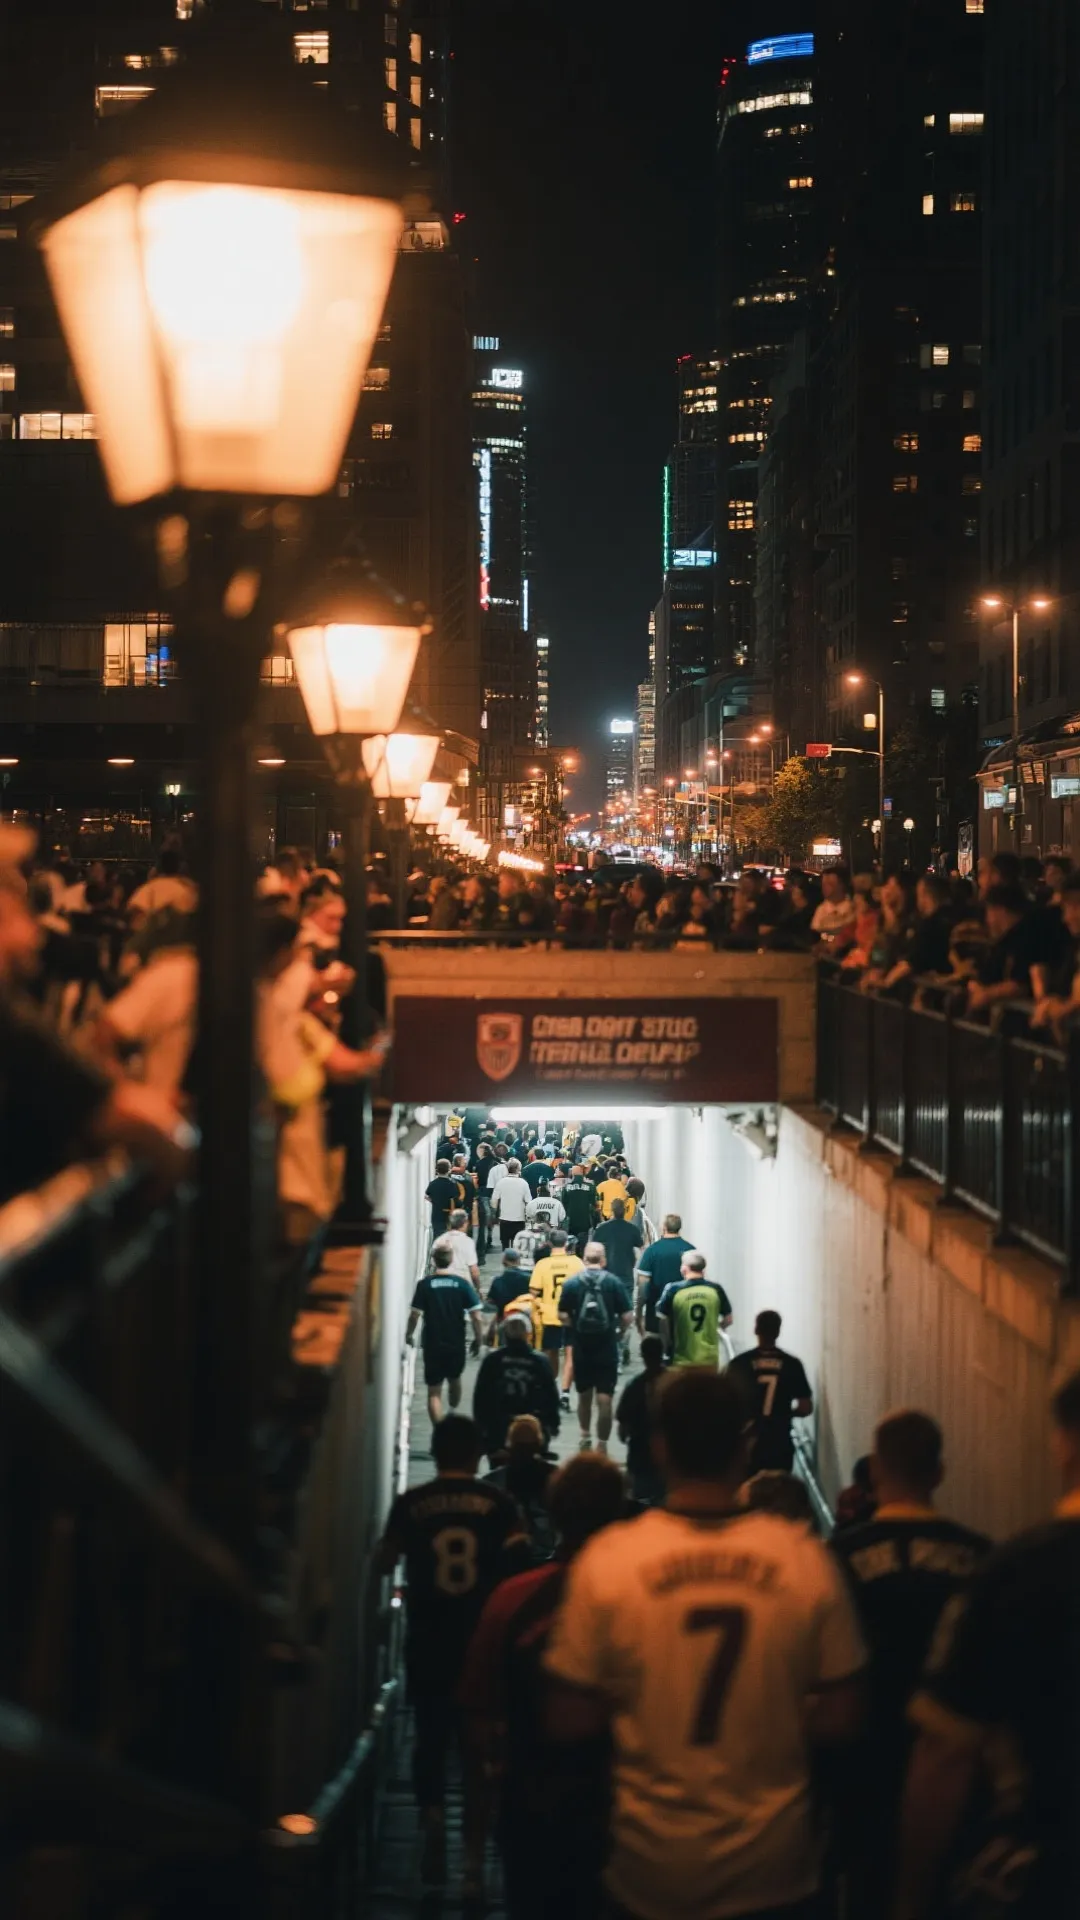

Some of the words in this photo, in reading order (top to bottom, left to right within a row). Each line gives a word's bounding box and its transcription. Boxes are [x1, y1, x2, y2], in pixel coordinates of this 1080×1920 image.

[690, 1303, 707, 1333] 9
[757, 1374, 779, 1417] 7
[435, 1526, 477, 1595] 8
[683, 1606, 749, 1747] 7
